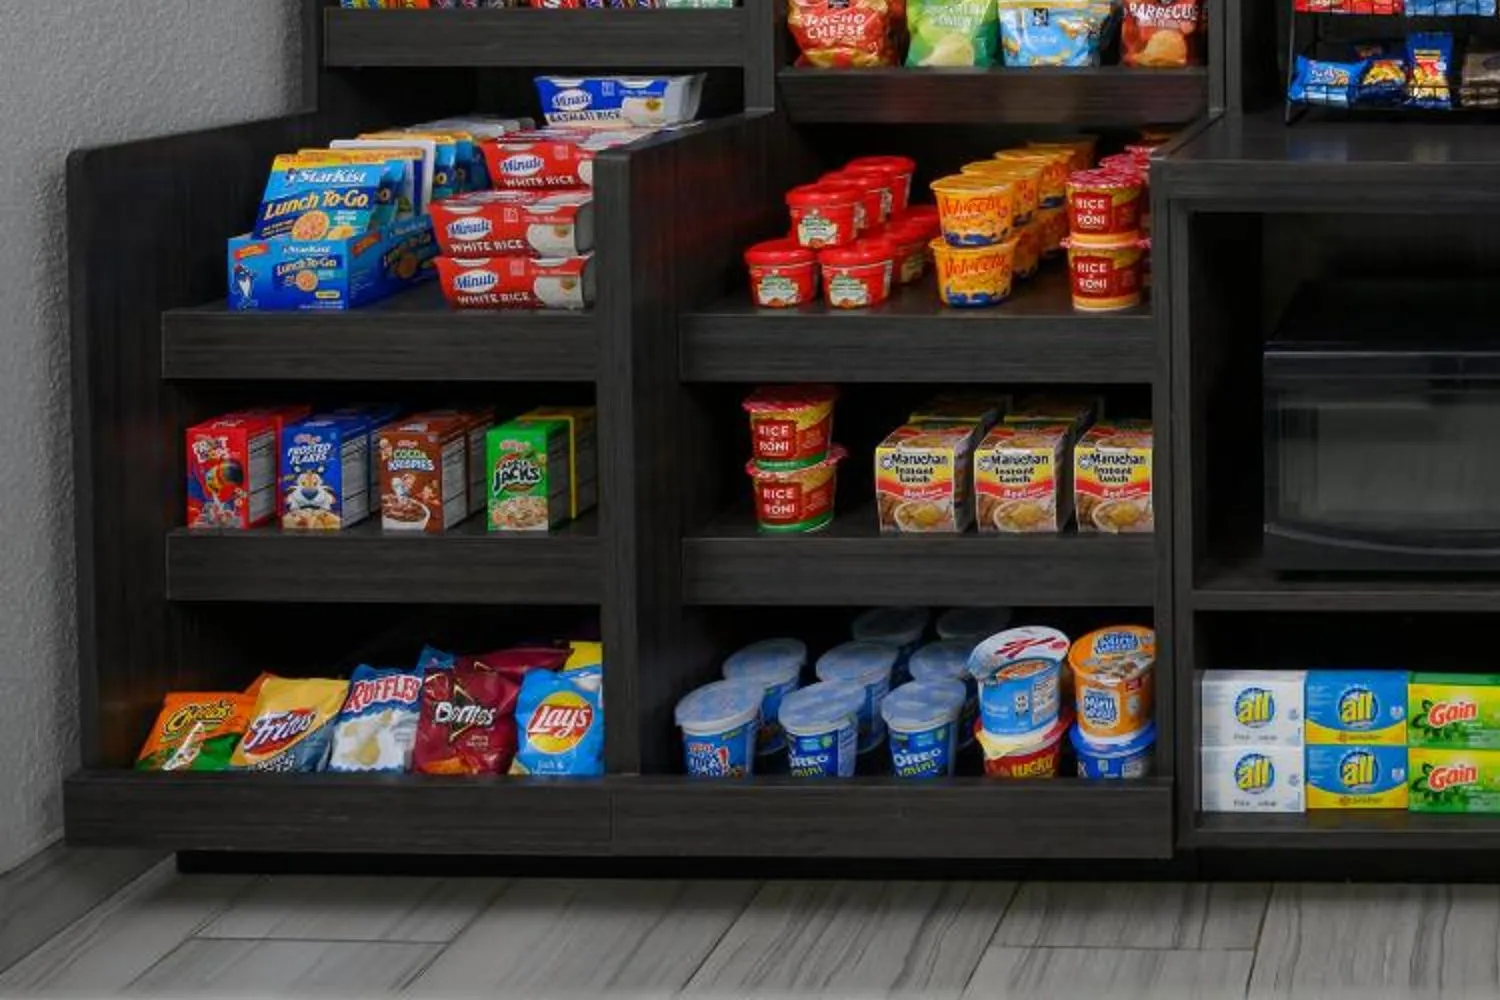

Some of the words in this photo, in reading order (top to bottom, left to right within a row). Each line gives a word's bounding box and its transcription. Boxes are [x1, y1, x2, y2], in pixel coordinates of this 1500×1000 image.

[297, 169, 367, 184] StarKist
[450, 241, 493, 253] WHITE
[494, 239, 525, 251] RICE
[891, 453, 949, 465] Maruchan
[992, 453, 1049, 465] Maruchan
[1091, 453, 1146, 465] Maruchan
[346, 675, 422, 713] RUFFLES
[1237, 690, 1273, 725] all
[1340, 690, 1374, 724] all
[435, 701, 497, 726] Doritos
[528, 704, 590, 738] Lay's
[1428, 701, 1477, 728] Gain
[1237, 757, 1271, 790] all
[1342, 755, 1375, 787] all
[1429, 764, 1477, 791] Gain
